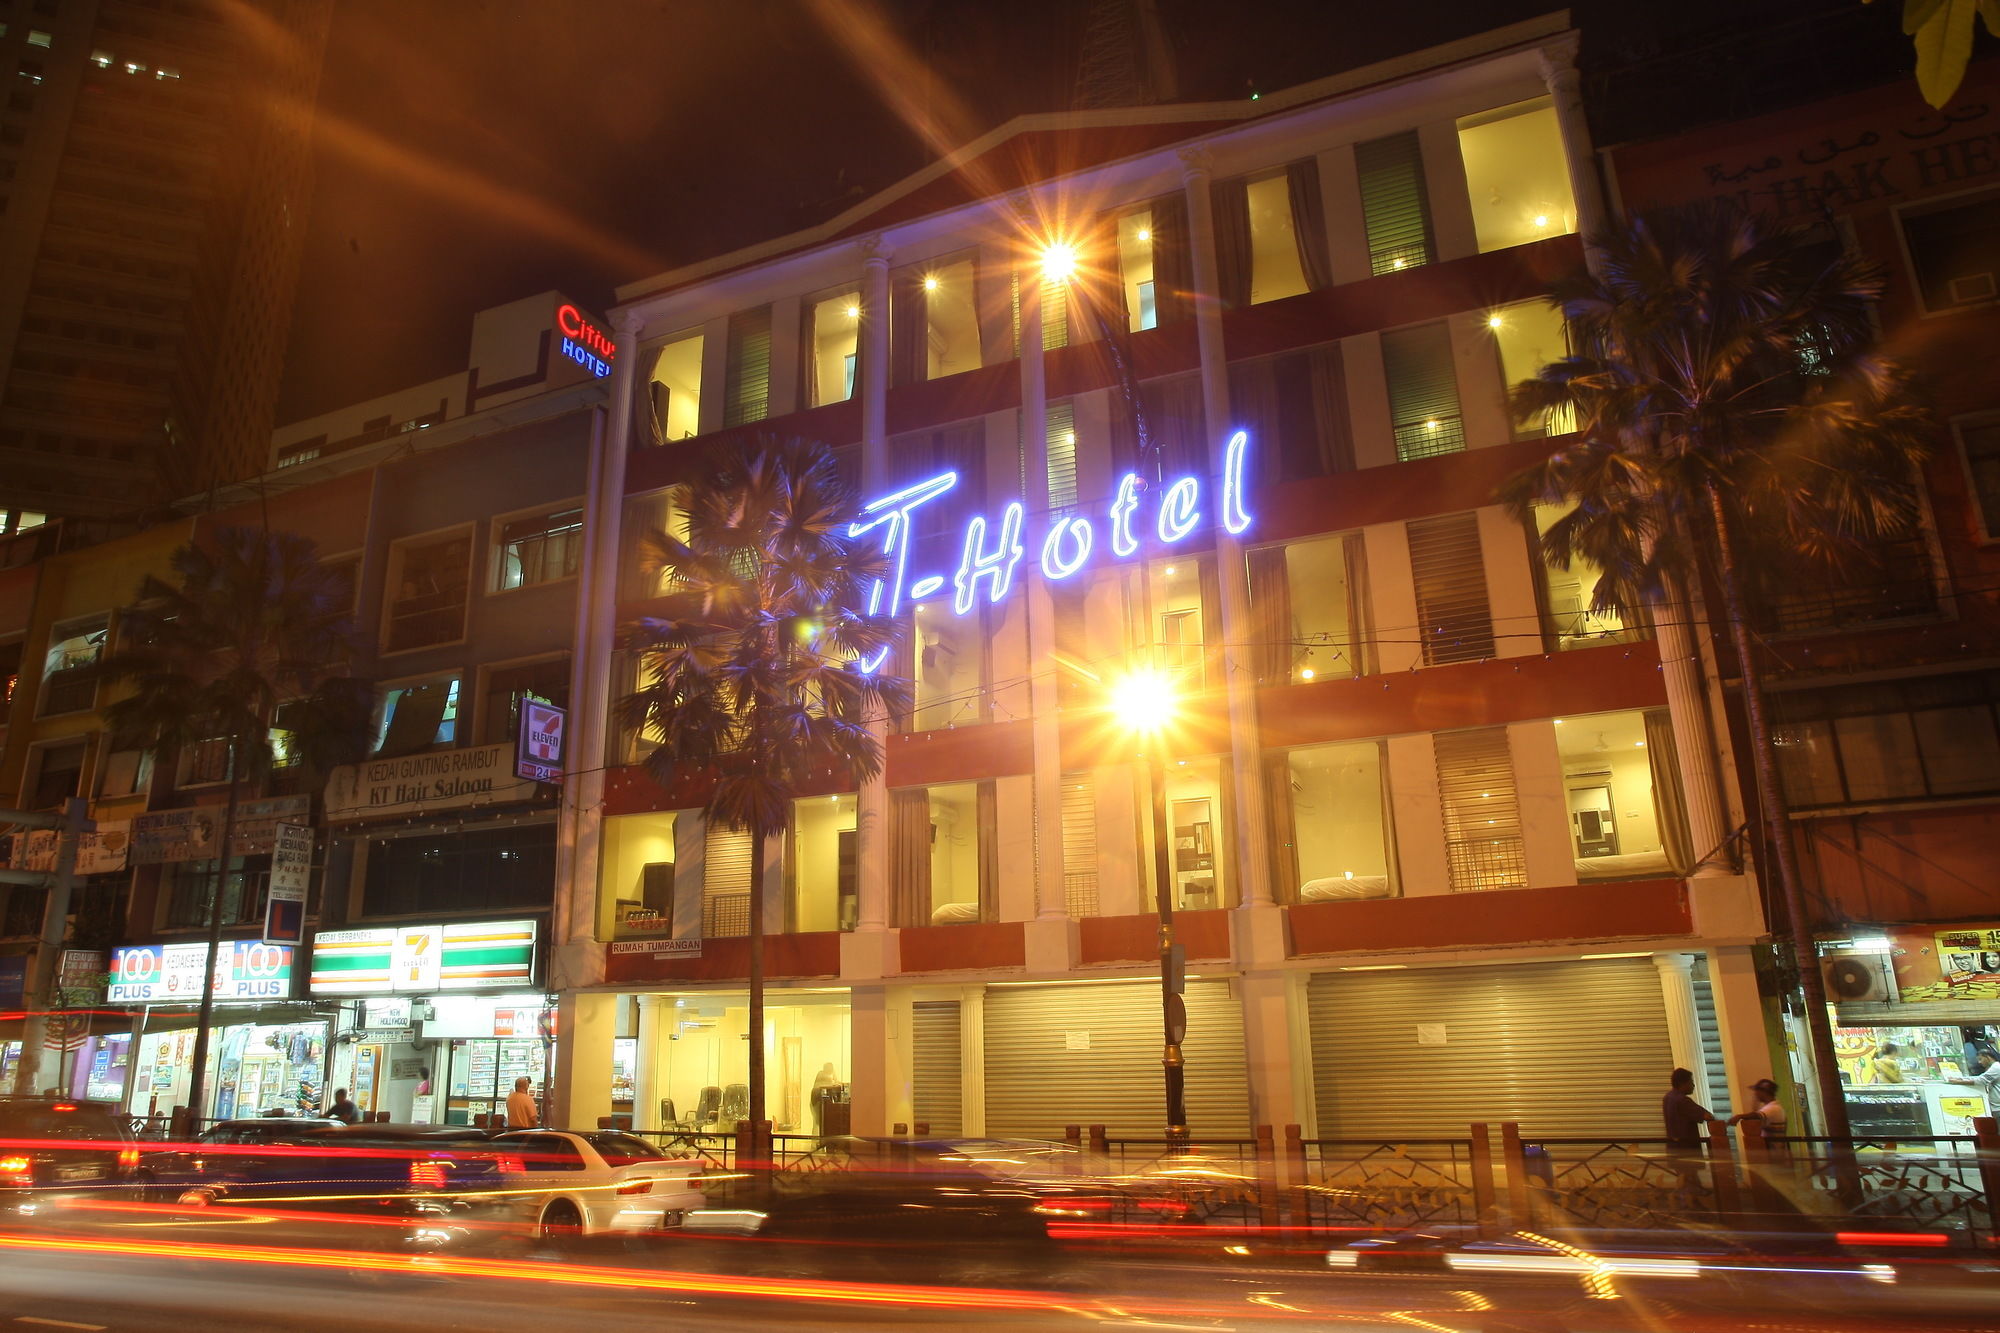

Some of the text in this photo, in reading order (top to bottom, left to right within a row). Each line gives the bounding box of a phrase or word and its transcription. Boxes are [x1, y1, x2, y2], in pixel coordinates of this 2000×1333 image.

[1768, 156, 1906, 218] HAK
[1908, 131, 2000, 190] HE
[367, 765, 398, 783] KEDAI
[400, 756, 450, 778] GUNTING
[452, 748, 500, 772] RAMBUT
[537, 767, 549, 778] 24
[370, 777, 493, 805] KT Hair Saloon
[271, 903, 296, 938] L
[318, 933, 336, 942] KEDAI
[613, 940, 700, 952] RUMAH TUMPANGAN
[1949, 932, 1979, 940] SUPER
[117, 948, 155, 982] 100
[240, 943, 283, 978] 100
[113, 985, 152, 999] PLUS
[237, 981, 281, 996] PLUS
